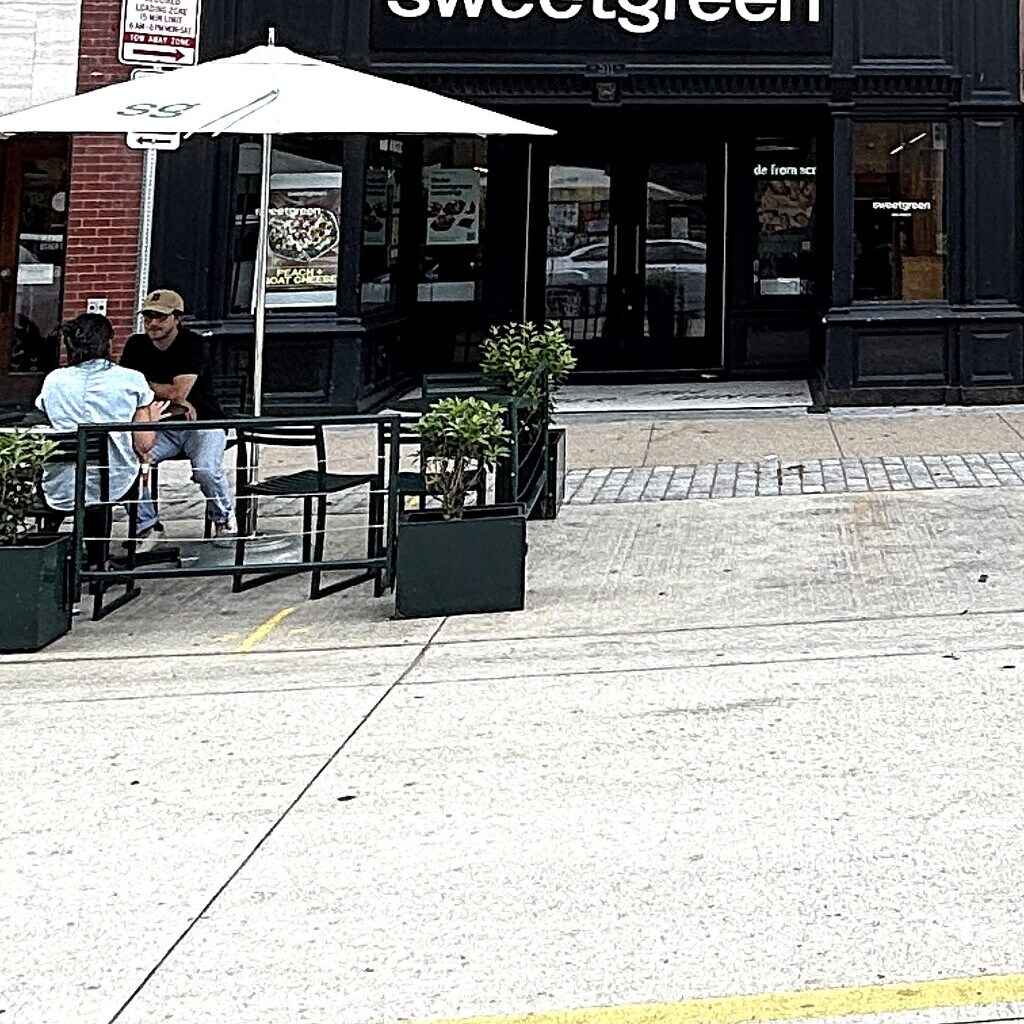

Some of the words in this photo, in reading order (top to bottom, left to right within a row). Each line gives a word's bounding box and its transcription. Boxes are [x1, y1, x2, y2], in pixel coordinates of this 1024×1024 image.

[135, 3, 167, 14] LOADING
[130, 34, 146, 43] TOW
[147, 35, 168, 44] AWAY
[170, 36, 191, 46] ZONE
[770, 164, 798, 176] from
[276, 268, 314, 277] PEACH
